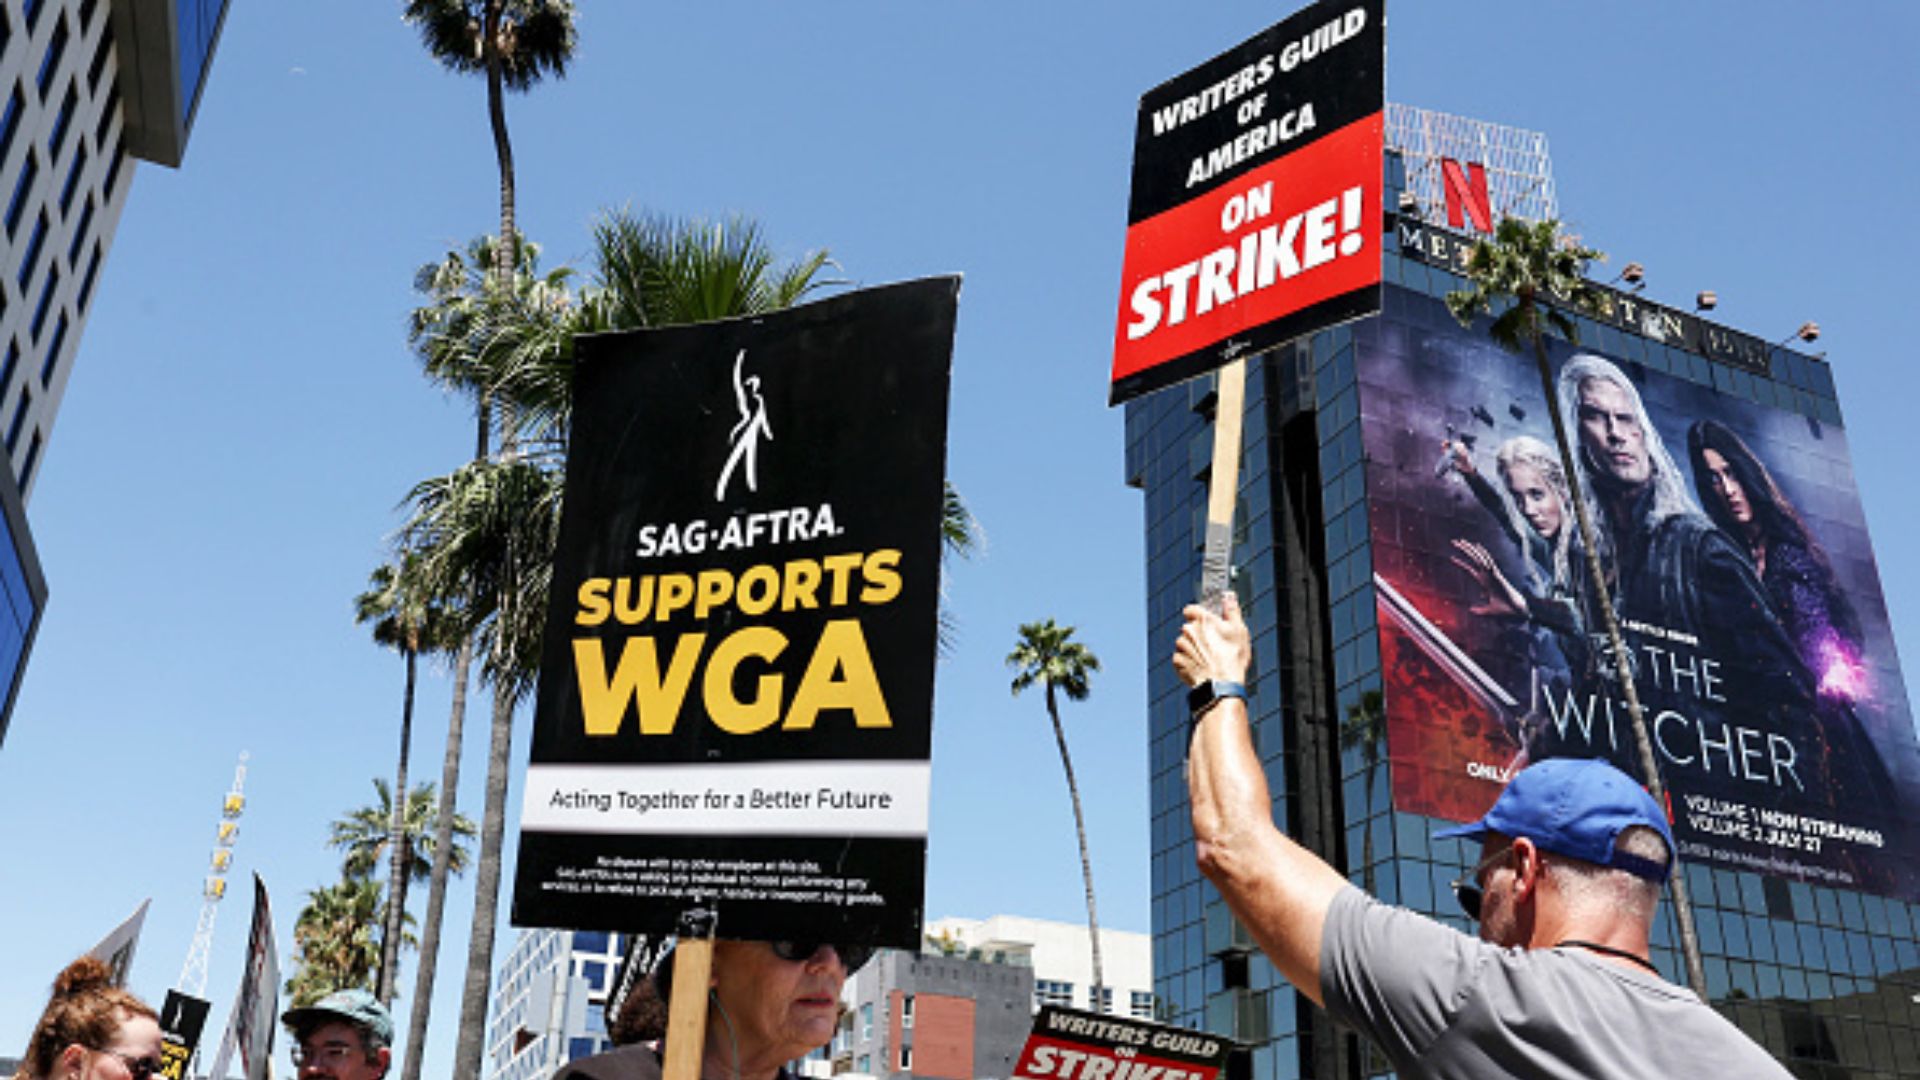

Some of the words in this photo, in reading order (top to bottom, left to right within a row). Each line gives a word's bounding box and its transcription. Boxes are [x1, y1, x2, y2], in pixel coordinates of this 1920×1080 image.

[1153, 55, 1274, 136] WRITERS
[1279, 8, 1367, 72] GUILD
[1237, 93, 1268, 126] OF
[1187, 103, 1316, 188] AMERICA
[1221, 181, 1274, 232] ON
[1441, 158, 1493, 234] N
[1128, 186, 1363, 340] STRIKE!
[575, 549, 902, 626] SUPPORTS
[572, 618, 893, 736] WGA
[1641, 644, 1727, 702] THE
[1542, 683, 1805, 791] WICHER
[1467, 762, 1511, 783] ONLY
[549, 789, 611, 811] Acting
[617, 790, 699, 814] Together
[703, 788, 730, 809] for
[734, 795, 744, 809] a
[749, 789, 811, 809] Better
[817, 788, 892, 809] Future
[1684, 794, 1749, 821] VOLUME
[1687, 813, 1751, 840] VOLUME
[1765, 828, 1800, 848] JULY
[1049, 1013, 1149, 1045] WRITERS
[1153, 1033, 1219, 1057] GUILD
[1114, 1046, 1138, 1058] ON
[1027, 1045, 1203, 1080] STRIK
